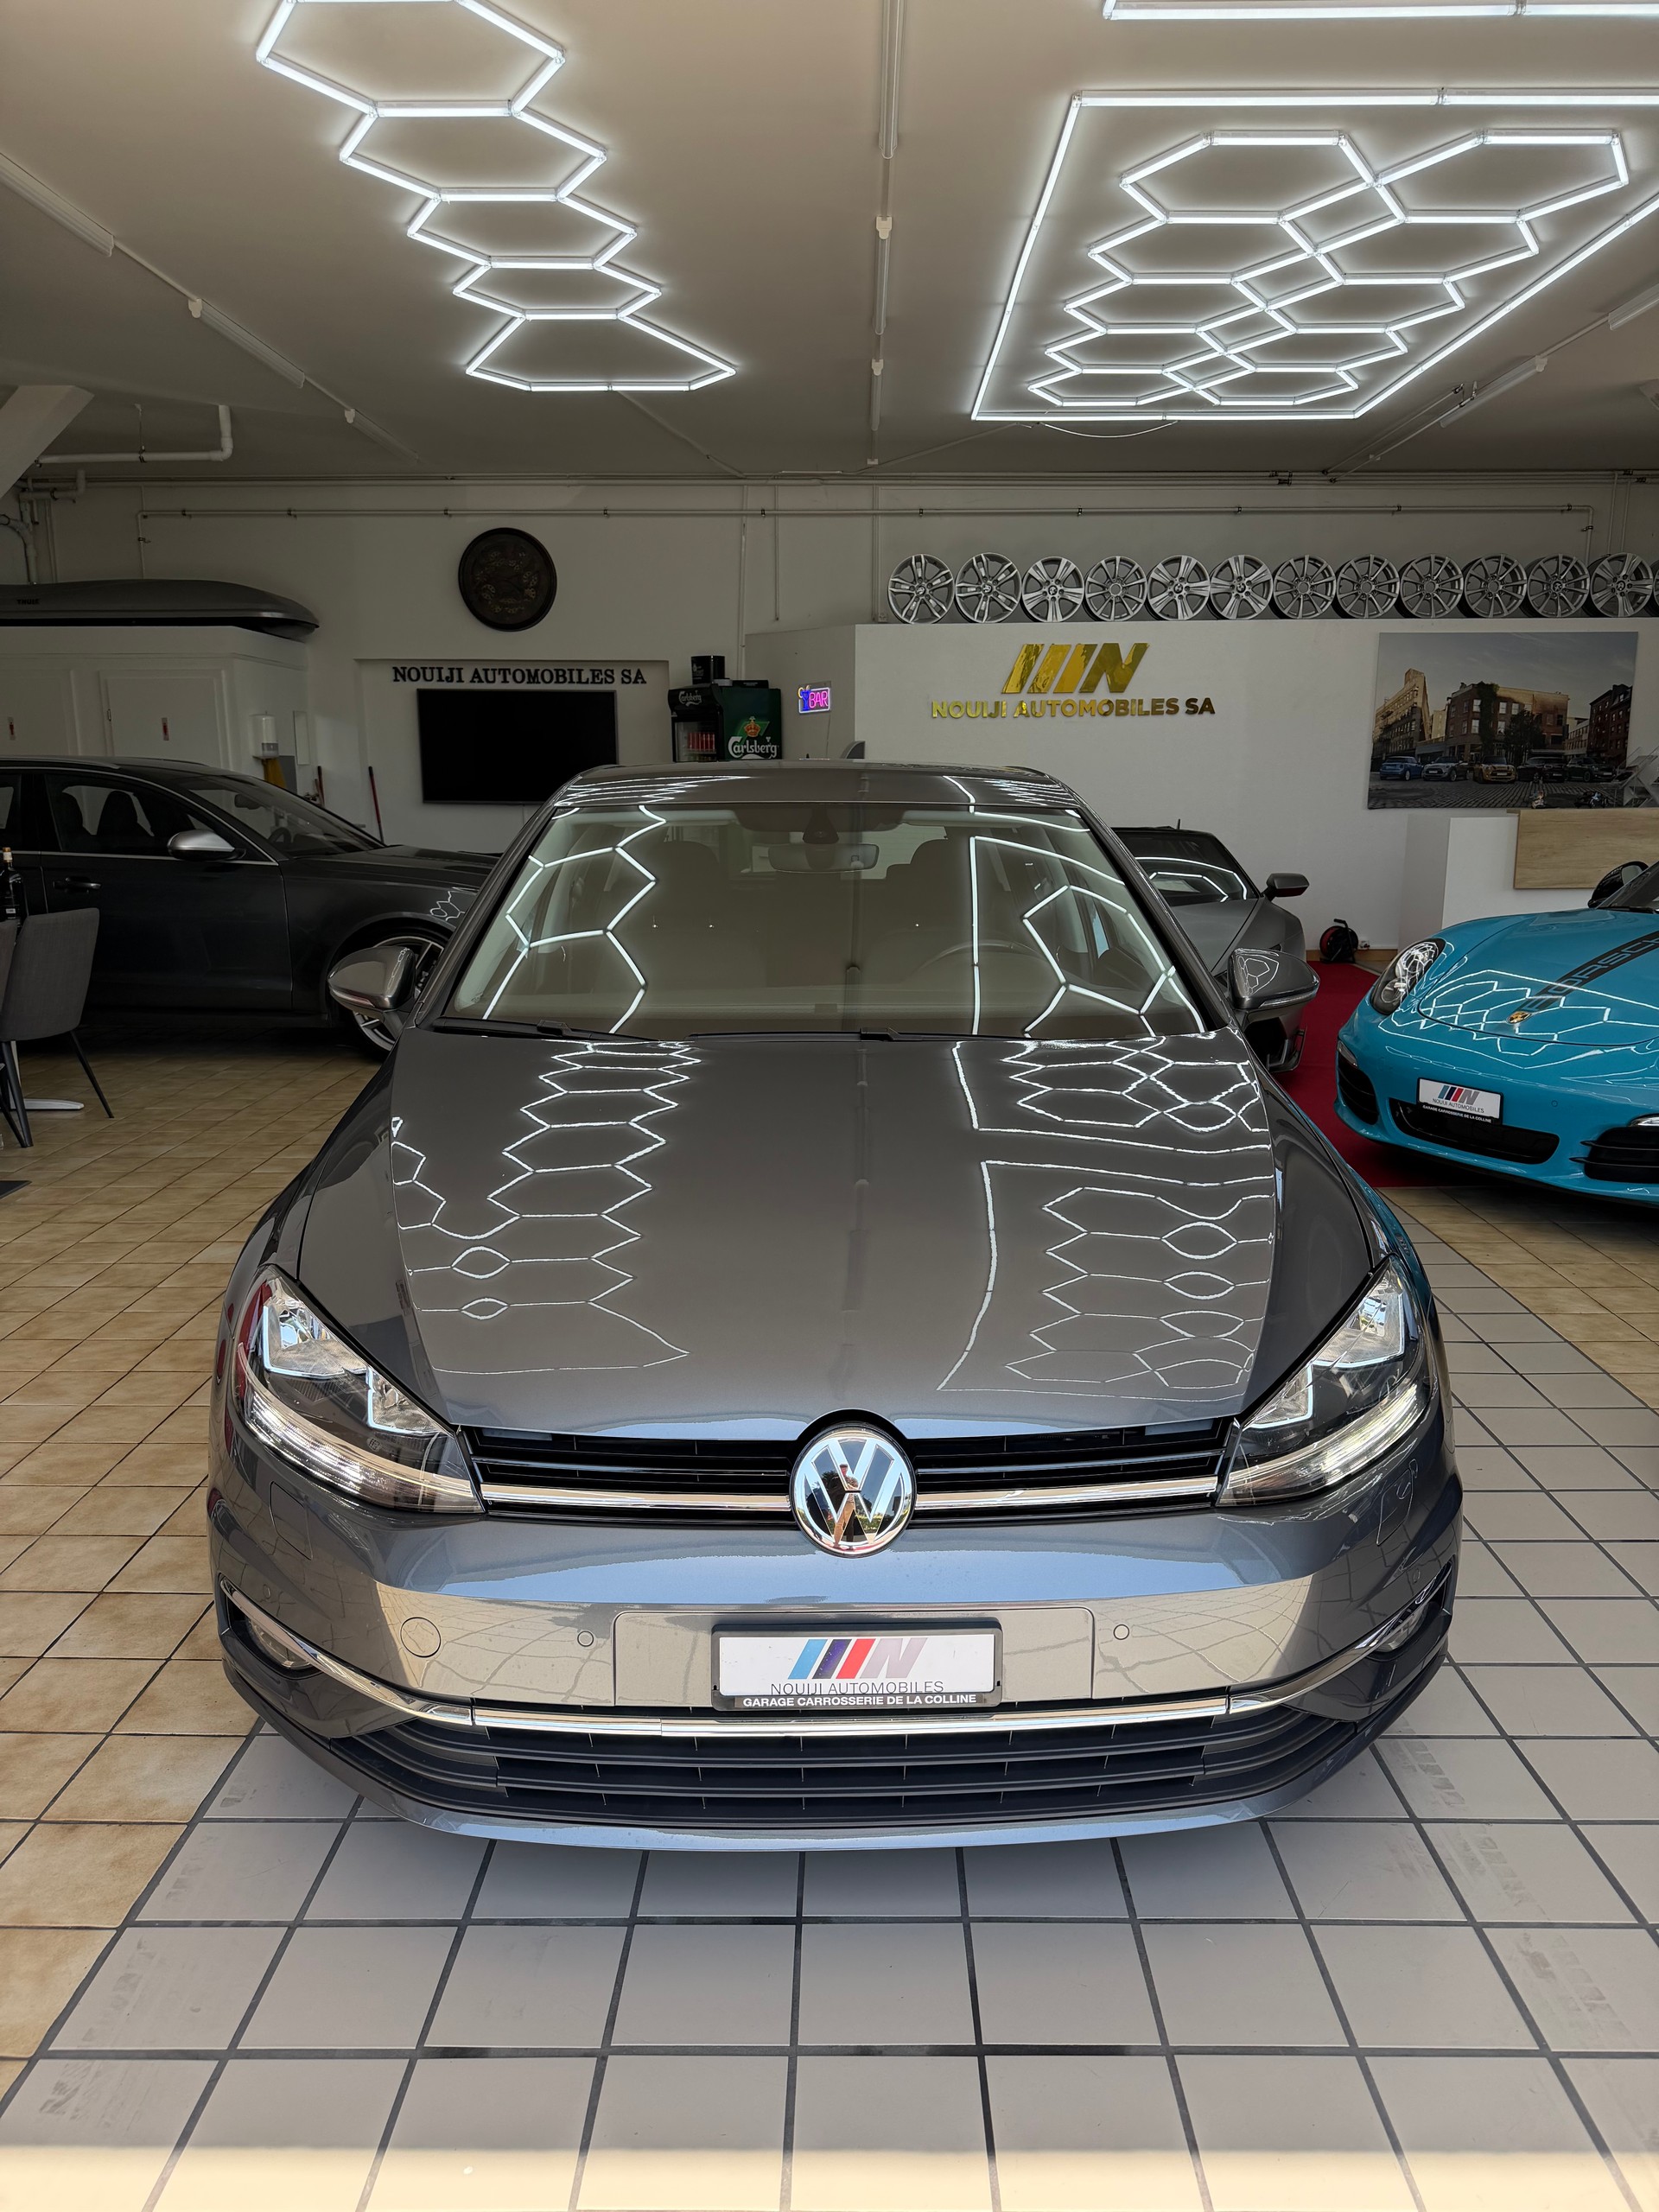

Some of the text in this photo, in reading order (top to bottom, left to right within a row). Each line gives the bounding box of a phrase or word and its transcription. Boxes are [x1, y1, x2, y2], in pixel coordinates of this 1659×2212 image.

[392, 666, 646, 684] NOUIJI AUTOMOBILES SA
[678, 691, 702, 702] Carlsberg
[809, 691, 828, 709] BAR
[931, 697, 1215, 718] NOUIJI AUTOMOBILES SA
[728, 736, 778, 760] Carlsberg
[1448, 1102, 1484, 1114] AUTOMOBILES
[771, 1681, 944, 1695] NOUIJI AUTOMOBILES
[743, 1694, 976, 1707] GARAGE CARROSSERIE DE LA COLLINE
